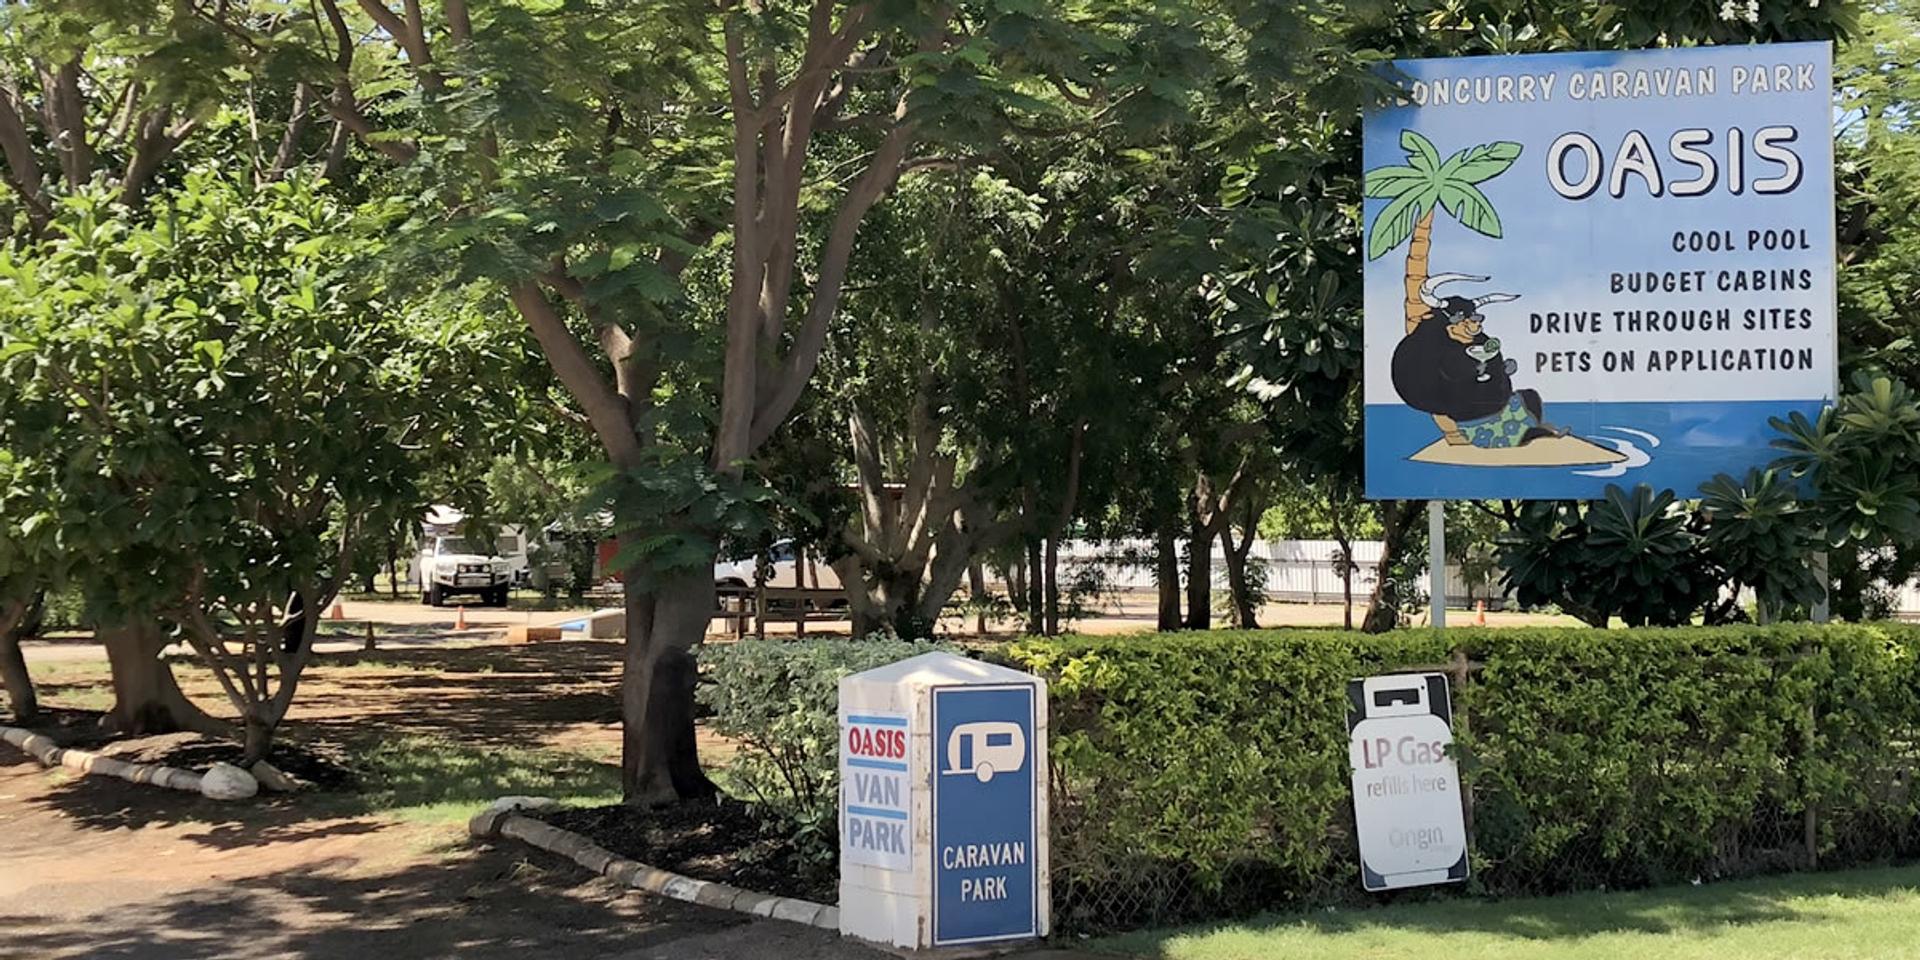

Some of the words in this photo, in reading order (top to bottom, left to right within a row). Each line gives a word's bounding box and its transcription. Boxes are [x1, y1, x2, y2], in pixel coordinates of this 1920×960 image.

[1568, 65, 1717, 99] CARAVAN
[1730, 63, 1816, 94] PARK
[1546, 125, 1804, 200] OASIS
[1672, 231, 1736, 252] COOL
[1748, 229, 1811, 251] POOL
[1610, 271, 1705, 294] BUDGET
[1717, 269, 1812, 292] CABINS
[1529, 312, 1602, 334] DRIVE
[1613, 310, 1730, 332] THROUGH
[1742, 308, 1812, 330] SITES
[1535, 351, 1591, 373] PETS
[1602, 350, 1635, 372] ON
[1647, 348, 1814, 372] APPLICATION
[848, 726, 906, 759] OASIS
[1362, 737, 1391, 769] LP
[1396, 736, 1445, 766] Gas
[854, 772, 900, 808] VAN
[1366, 775, 1409, 798] refills
[1412, 774, 1447, 795] here
[849, 817, 905, 855] PARK
[942, 841, 1026, 870] CARAVAN
[961, 876, 1008, 902] PARK
